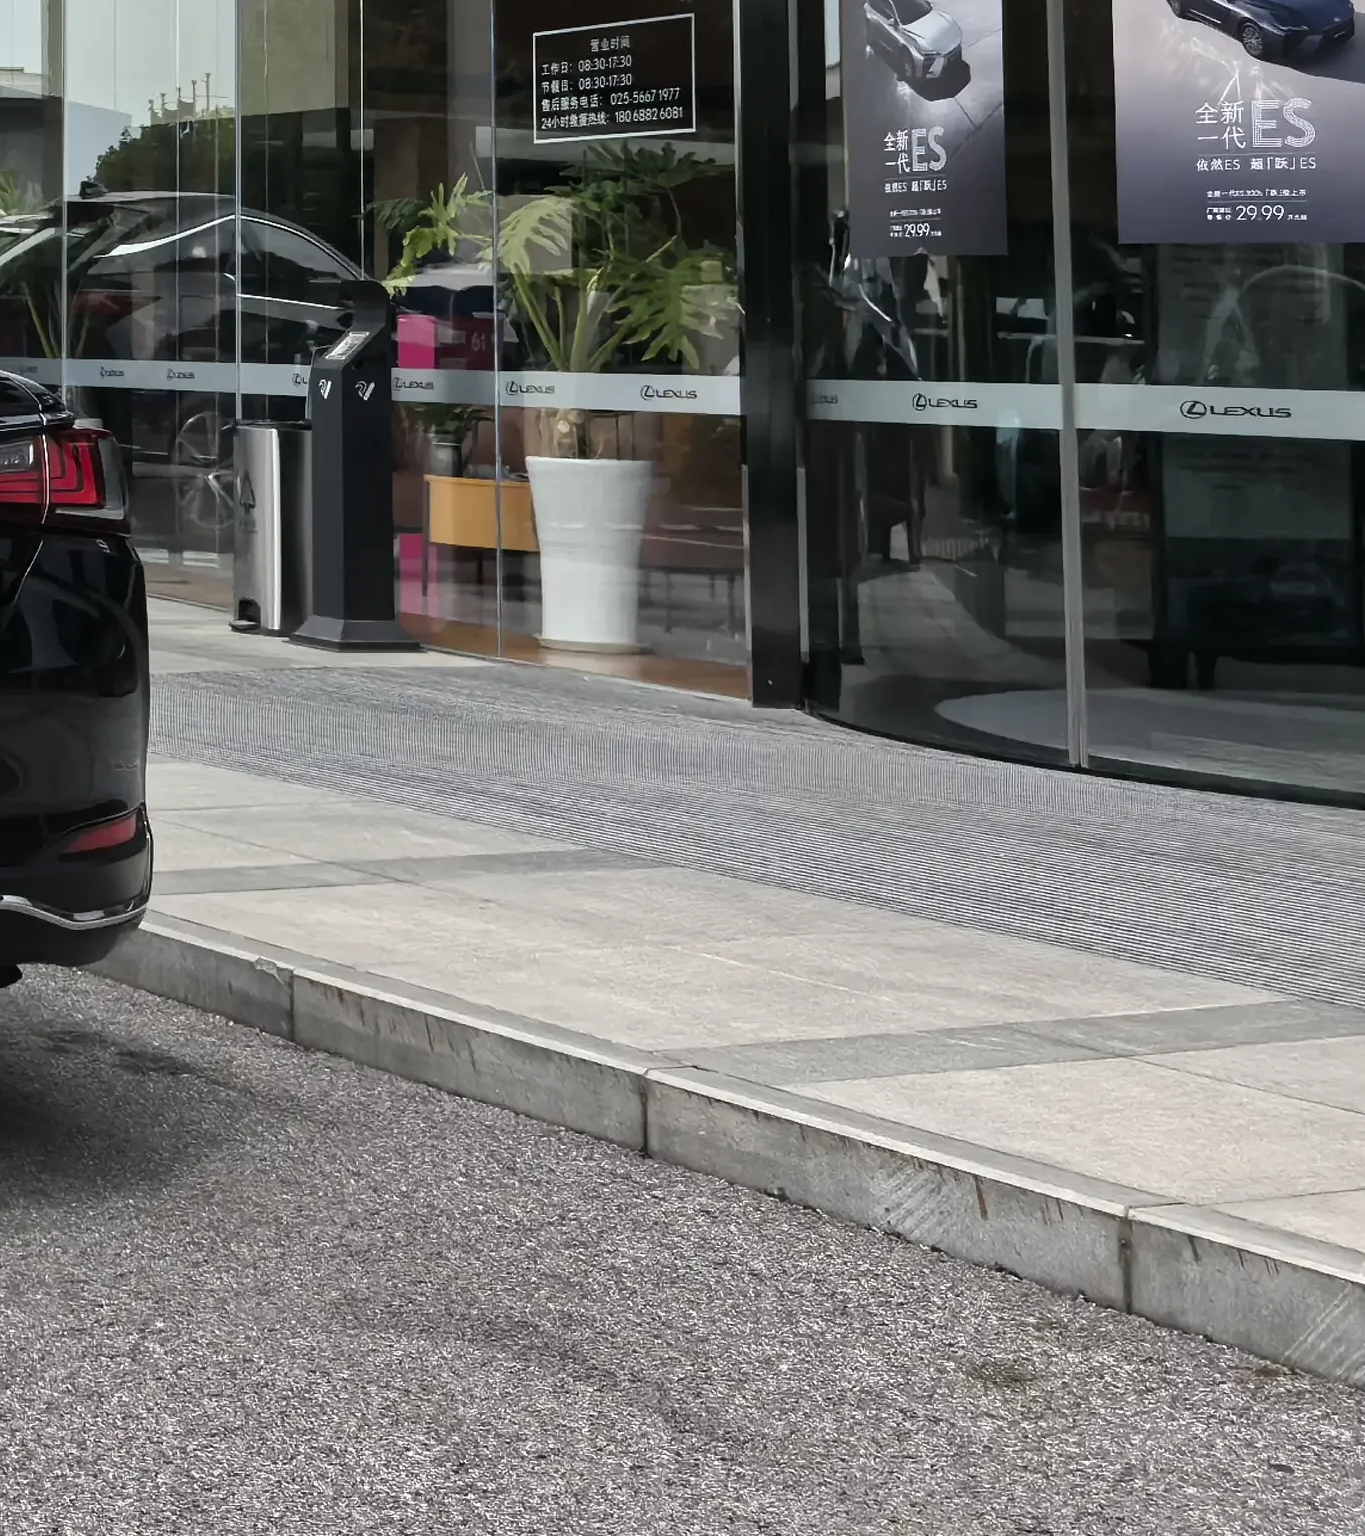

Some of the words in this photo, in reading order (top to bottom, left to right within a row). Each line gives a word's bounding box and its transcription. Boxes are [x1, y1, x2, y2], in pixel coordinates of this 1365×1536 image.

[577, 54, 632, 72] 08:30-17:30
[577, 73, 633, 91] 08:30-17:30
[1195, 100, 1245, 124] 全新
[1251, 98, 1316, 148] ES
[883, 129, 909, 151] 全新
[1197, 126, 1247, 150] 一代
[911, 126, 947, 172] ES
[885, 152, 910, 174] 一代
[1235, 204, 1285, 221] 29.99
[401, 380, 434, 390] LEXUS
[519, 384, 556, 394] LEXUS
[655, 389, 698, 400] LEXUS
[928, 399, 979, 409] LEXUS
[1209, 405, 1292, 419] LEXUS
